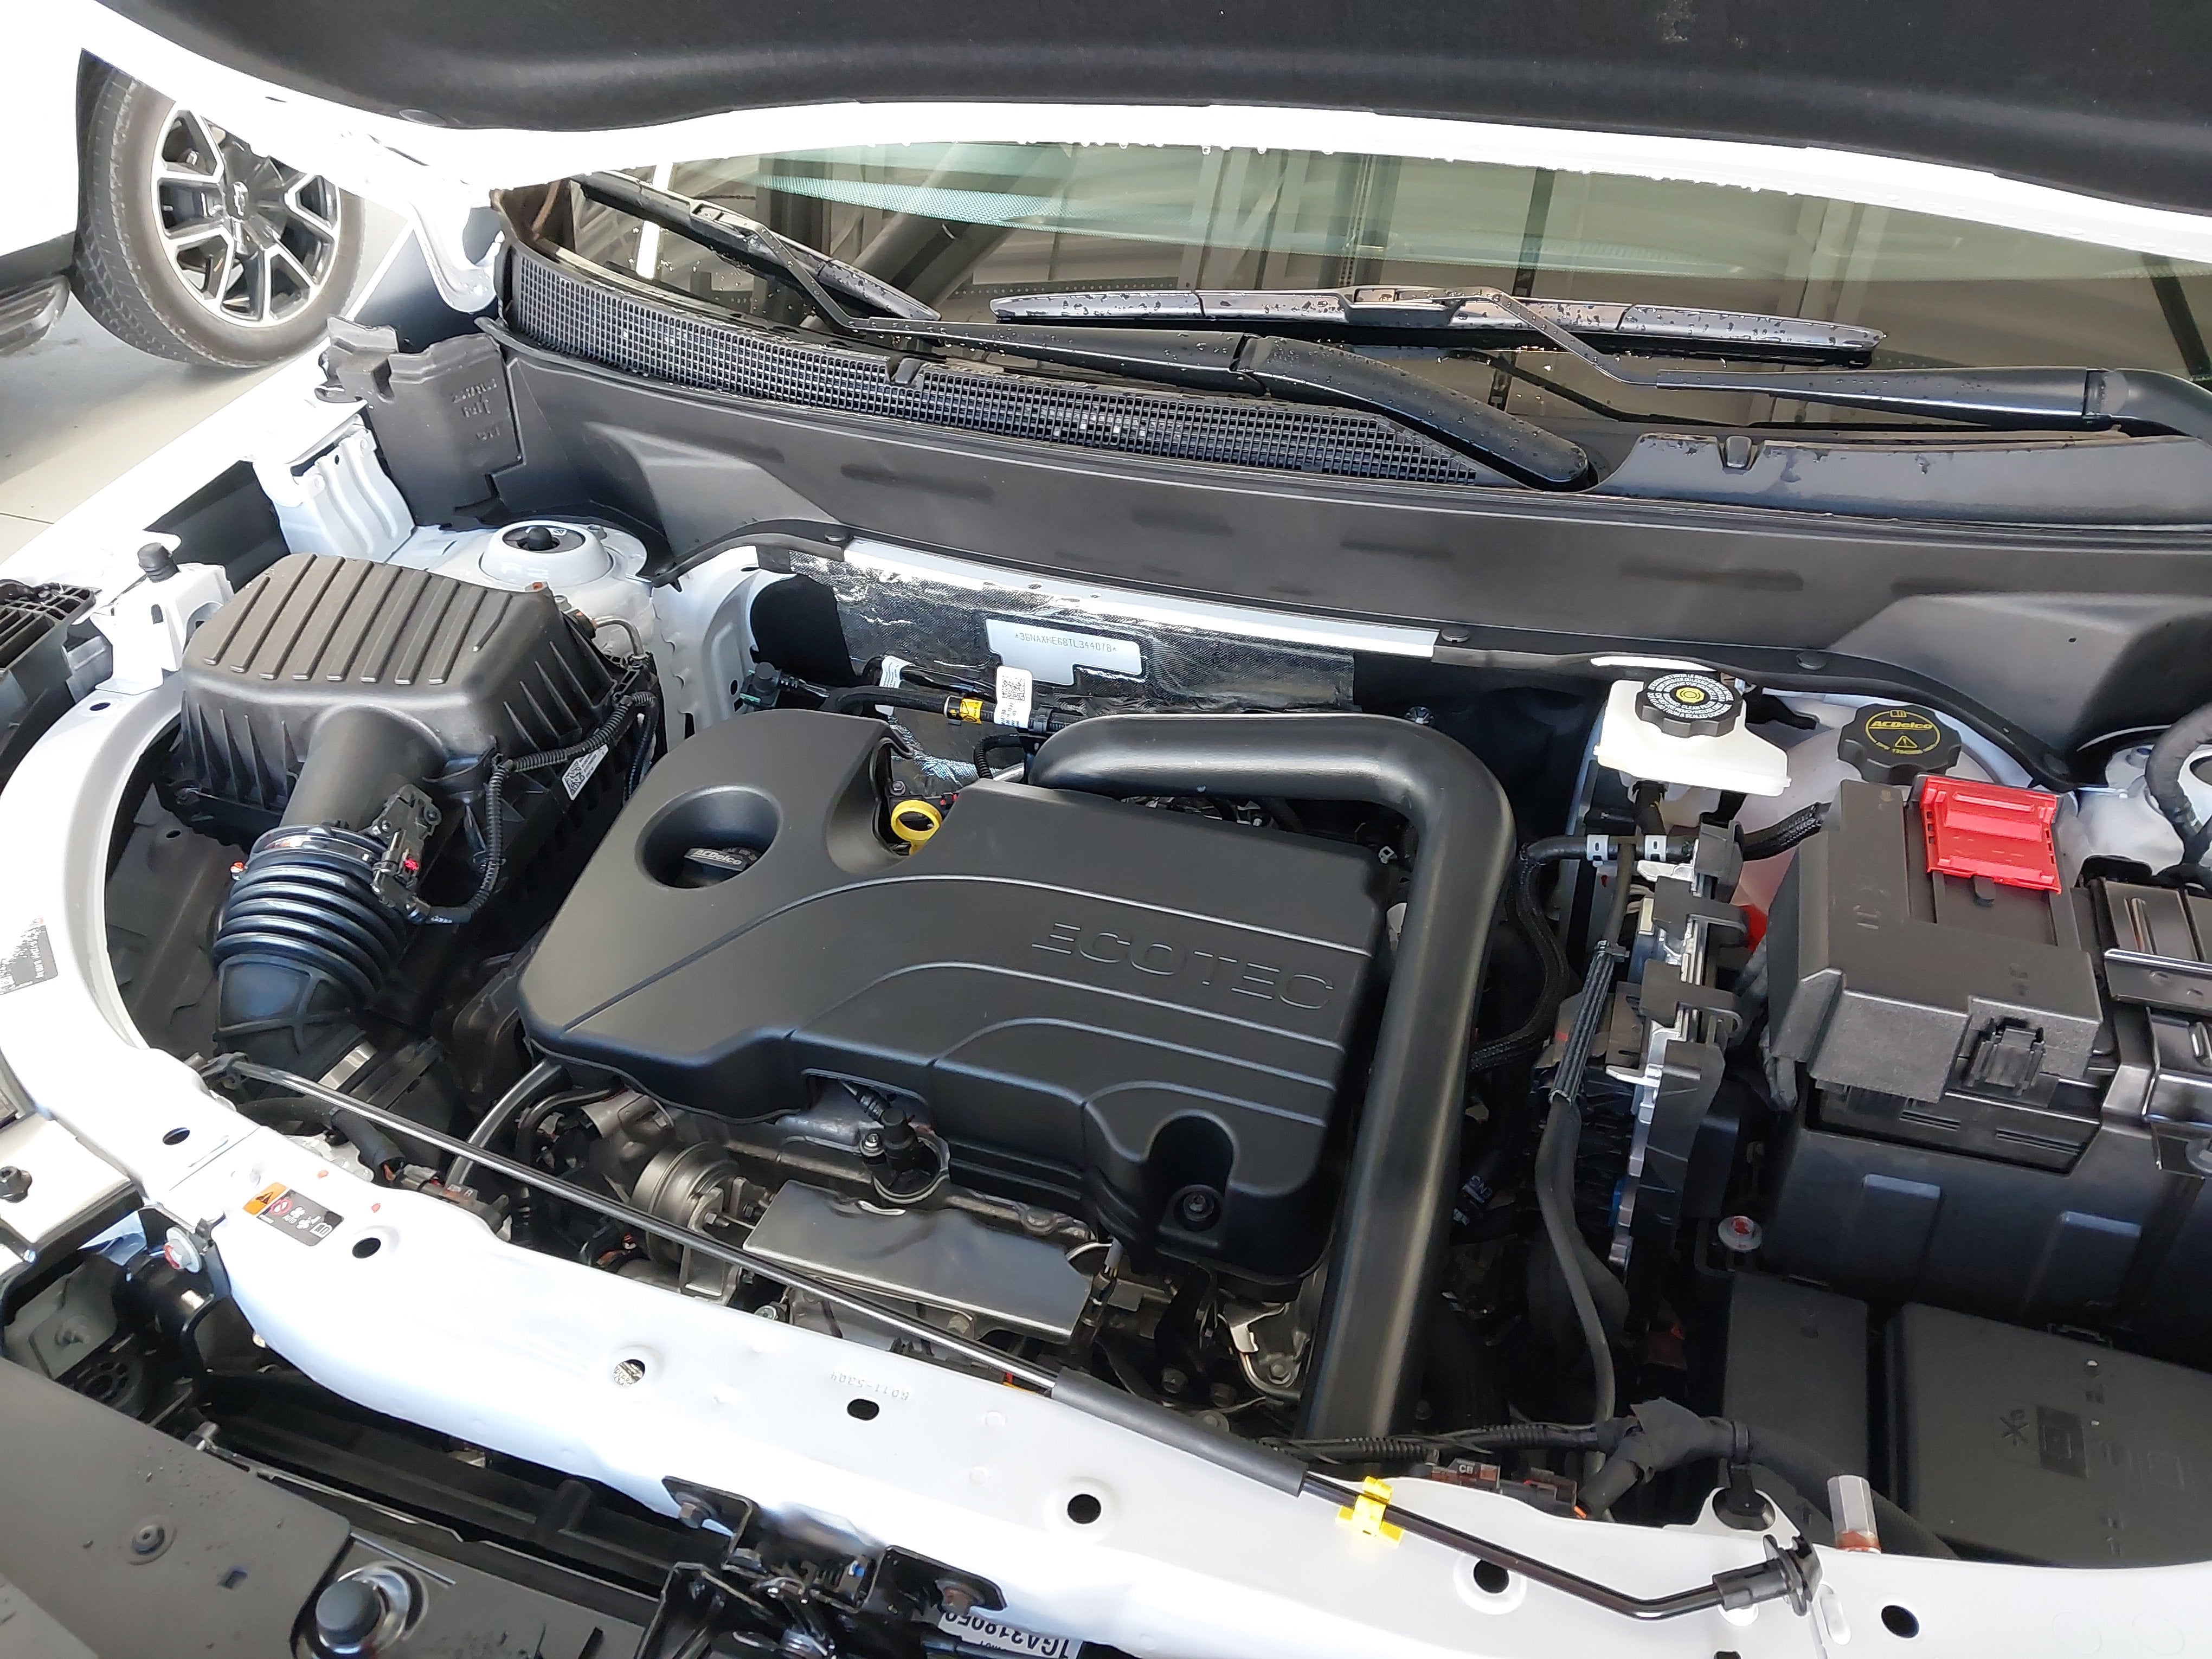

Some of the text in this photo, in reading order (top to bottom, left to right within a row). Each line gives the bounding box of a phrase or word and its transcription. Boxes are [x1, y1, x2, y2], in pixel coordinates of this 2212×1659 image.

[1871, 720, 1933, 729] ACDelco
[692, 850, 743, 865] ACDelco
[1031, 921, 1334, 1009] ECOTEC
